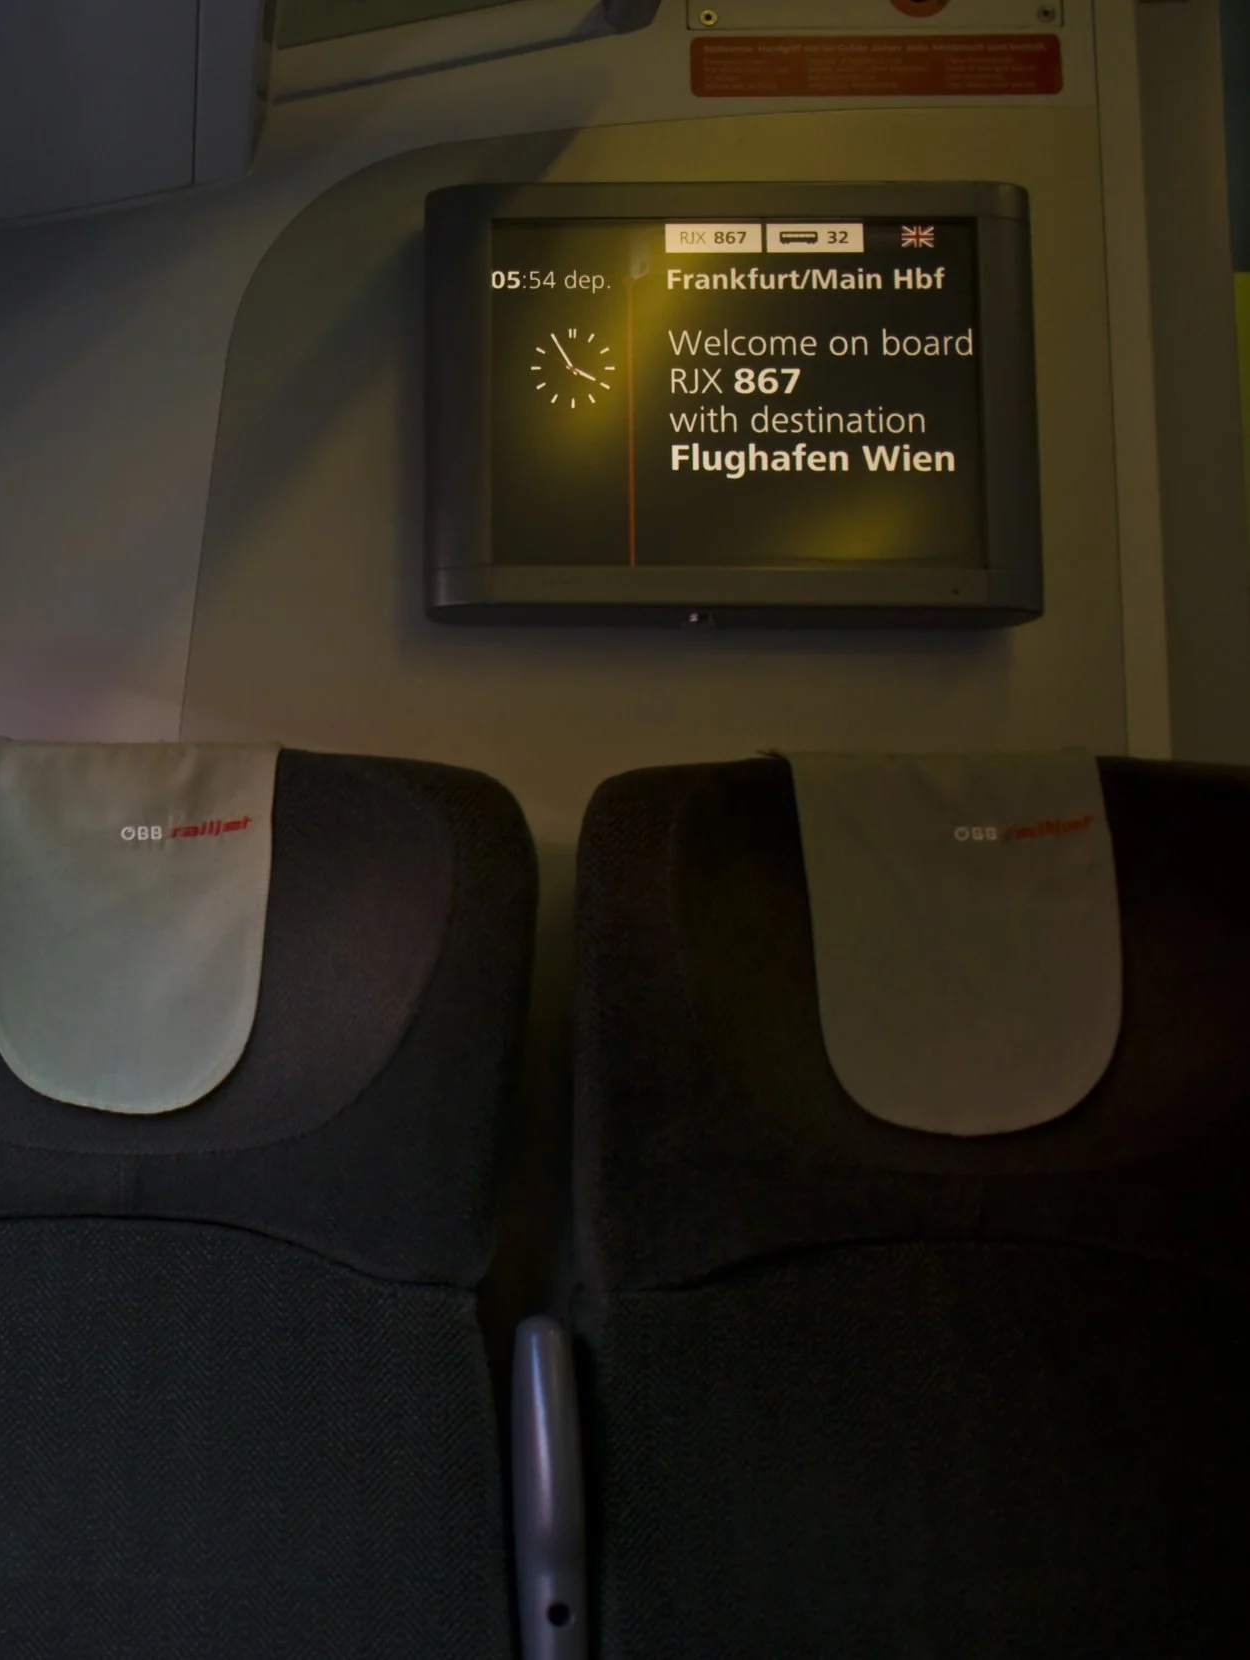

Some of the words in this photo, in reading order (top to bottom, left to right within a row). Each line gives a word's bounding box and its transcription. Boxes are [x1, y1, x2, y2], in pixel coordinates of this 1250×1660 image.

[680, 231, 706, 245] RJX
[713, 231, 748, 245] 867
[827, 231, 850, 245] 32
[491, 271, 556, 289] 05:54
[564, 270, 611, 294] dep.
[667, 268, 882, 290] Frankfurt/Main
[894, 267, 945, 290] Hbf
[668, 328, 817, 356] Welcome
[829, 336, 868, 356] on
[882, 328, 973, 356] board
[670, 368, 723, 394] RJX
[734, 368, 801, 394] 867
[669, 406, 738, 433] with
[751, 406, 925, 433] destination
[671, 443, 849, 479] Flughafen
[862, 445, 955, 472] Wien
